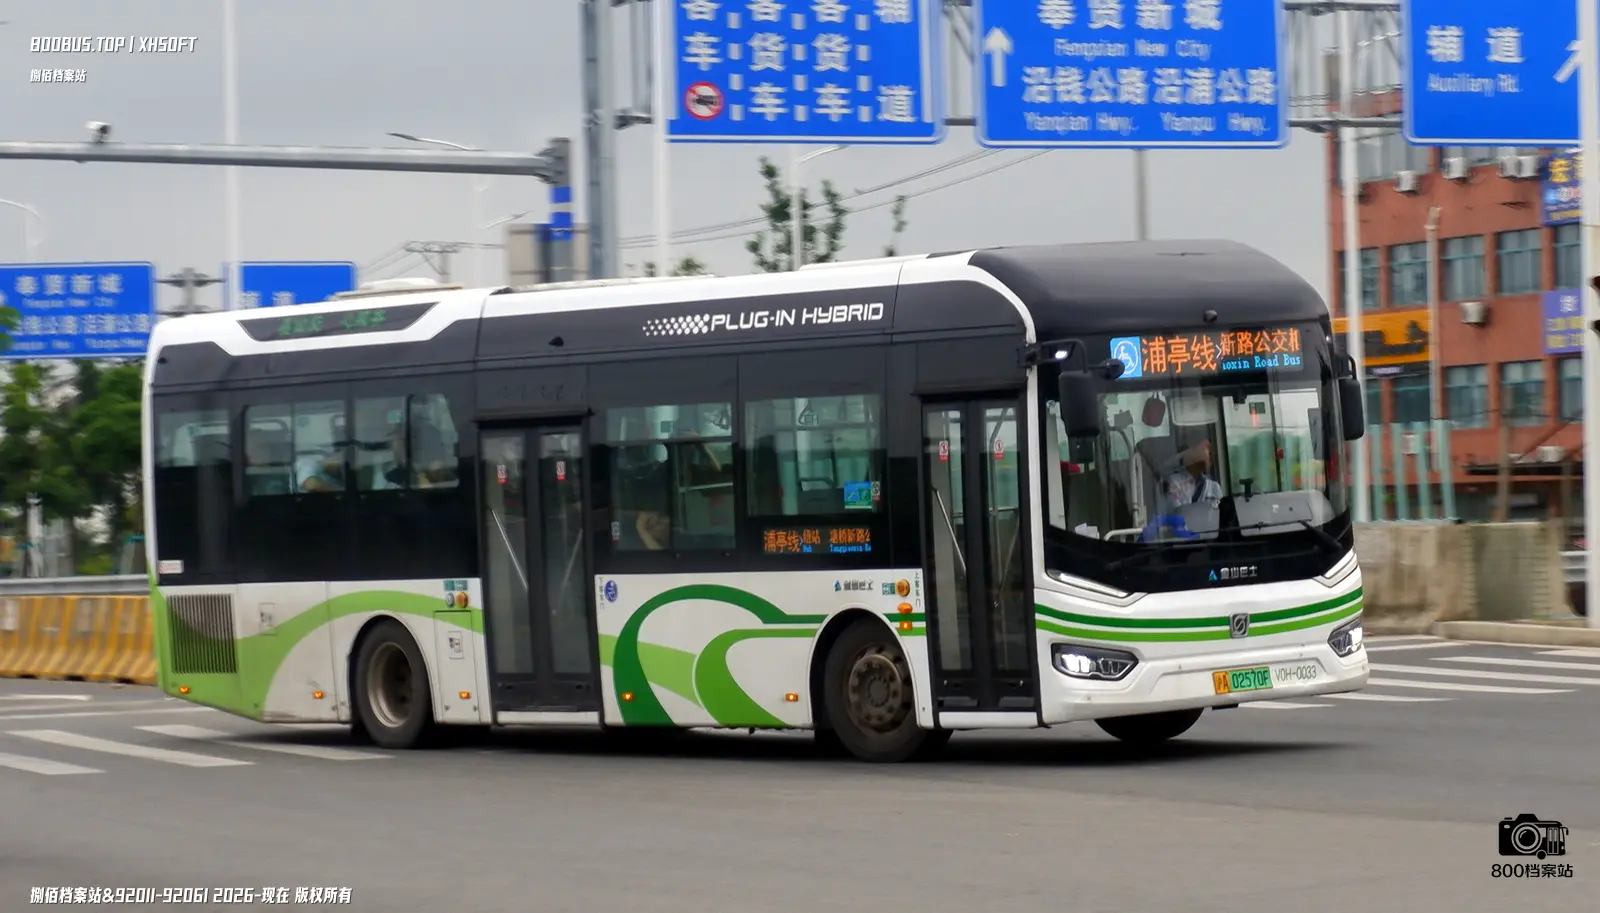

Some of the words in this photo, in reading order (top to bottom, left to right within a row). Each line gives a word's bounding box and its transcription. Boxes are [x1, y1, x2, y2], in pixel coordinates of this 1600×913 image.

[1036, 0, 1224, 30] 奉贤新城
[1134, 39, 1168, 57] New
[1175, 39, 1212, 61] City
[1425, 25, 1526, 63] 辅道
[711, 309, 796, 331] PLUG-IN
[801, 303, 884, 325] HYBRID
[1142, 335, 1216, 374] 浦亭线
[1254, 354, 1279, 367] Road
[1283, 352, 1301, 366] Bus
